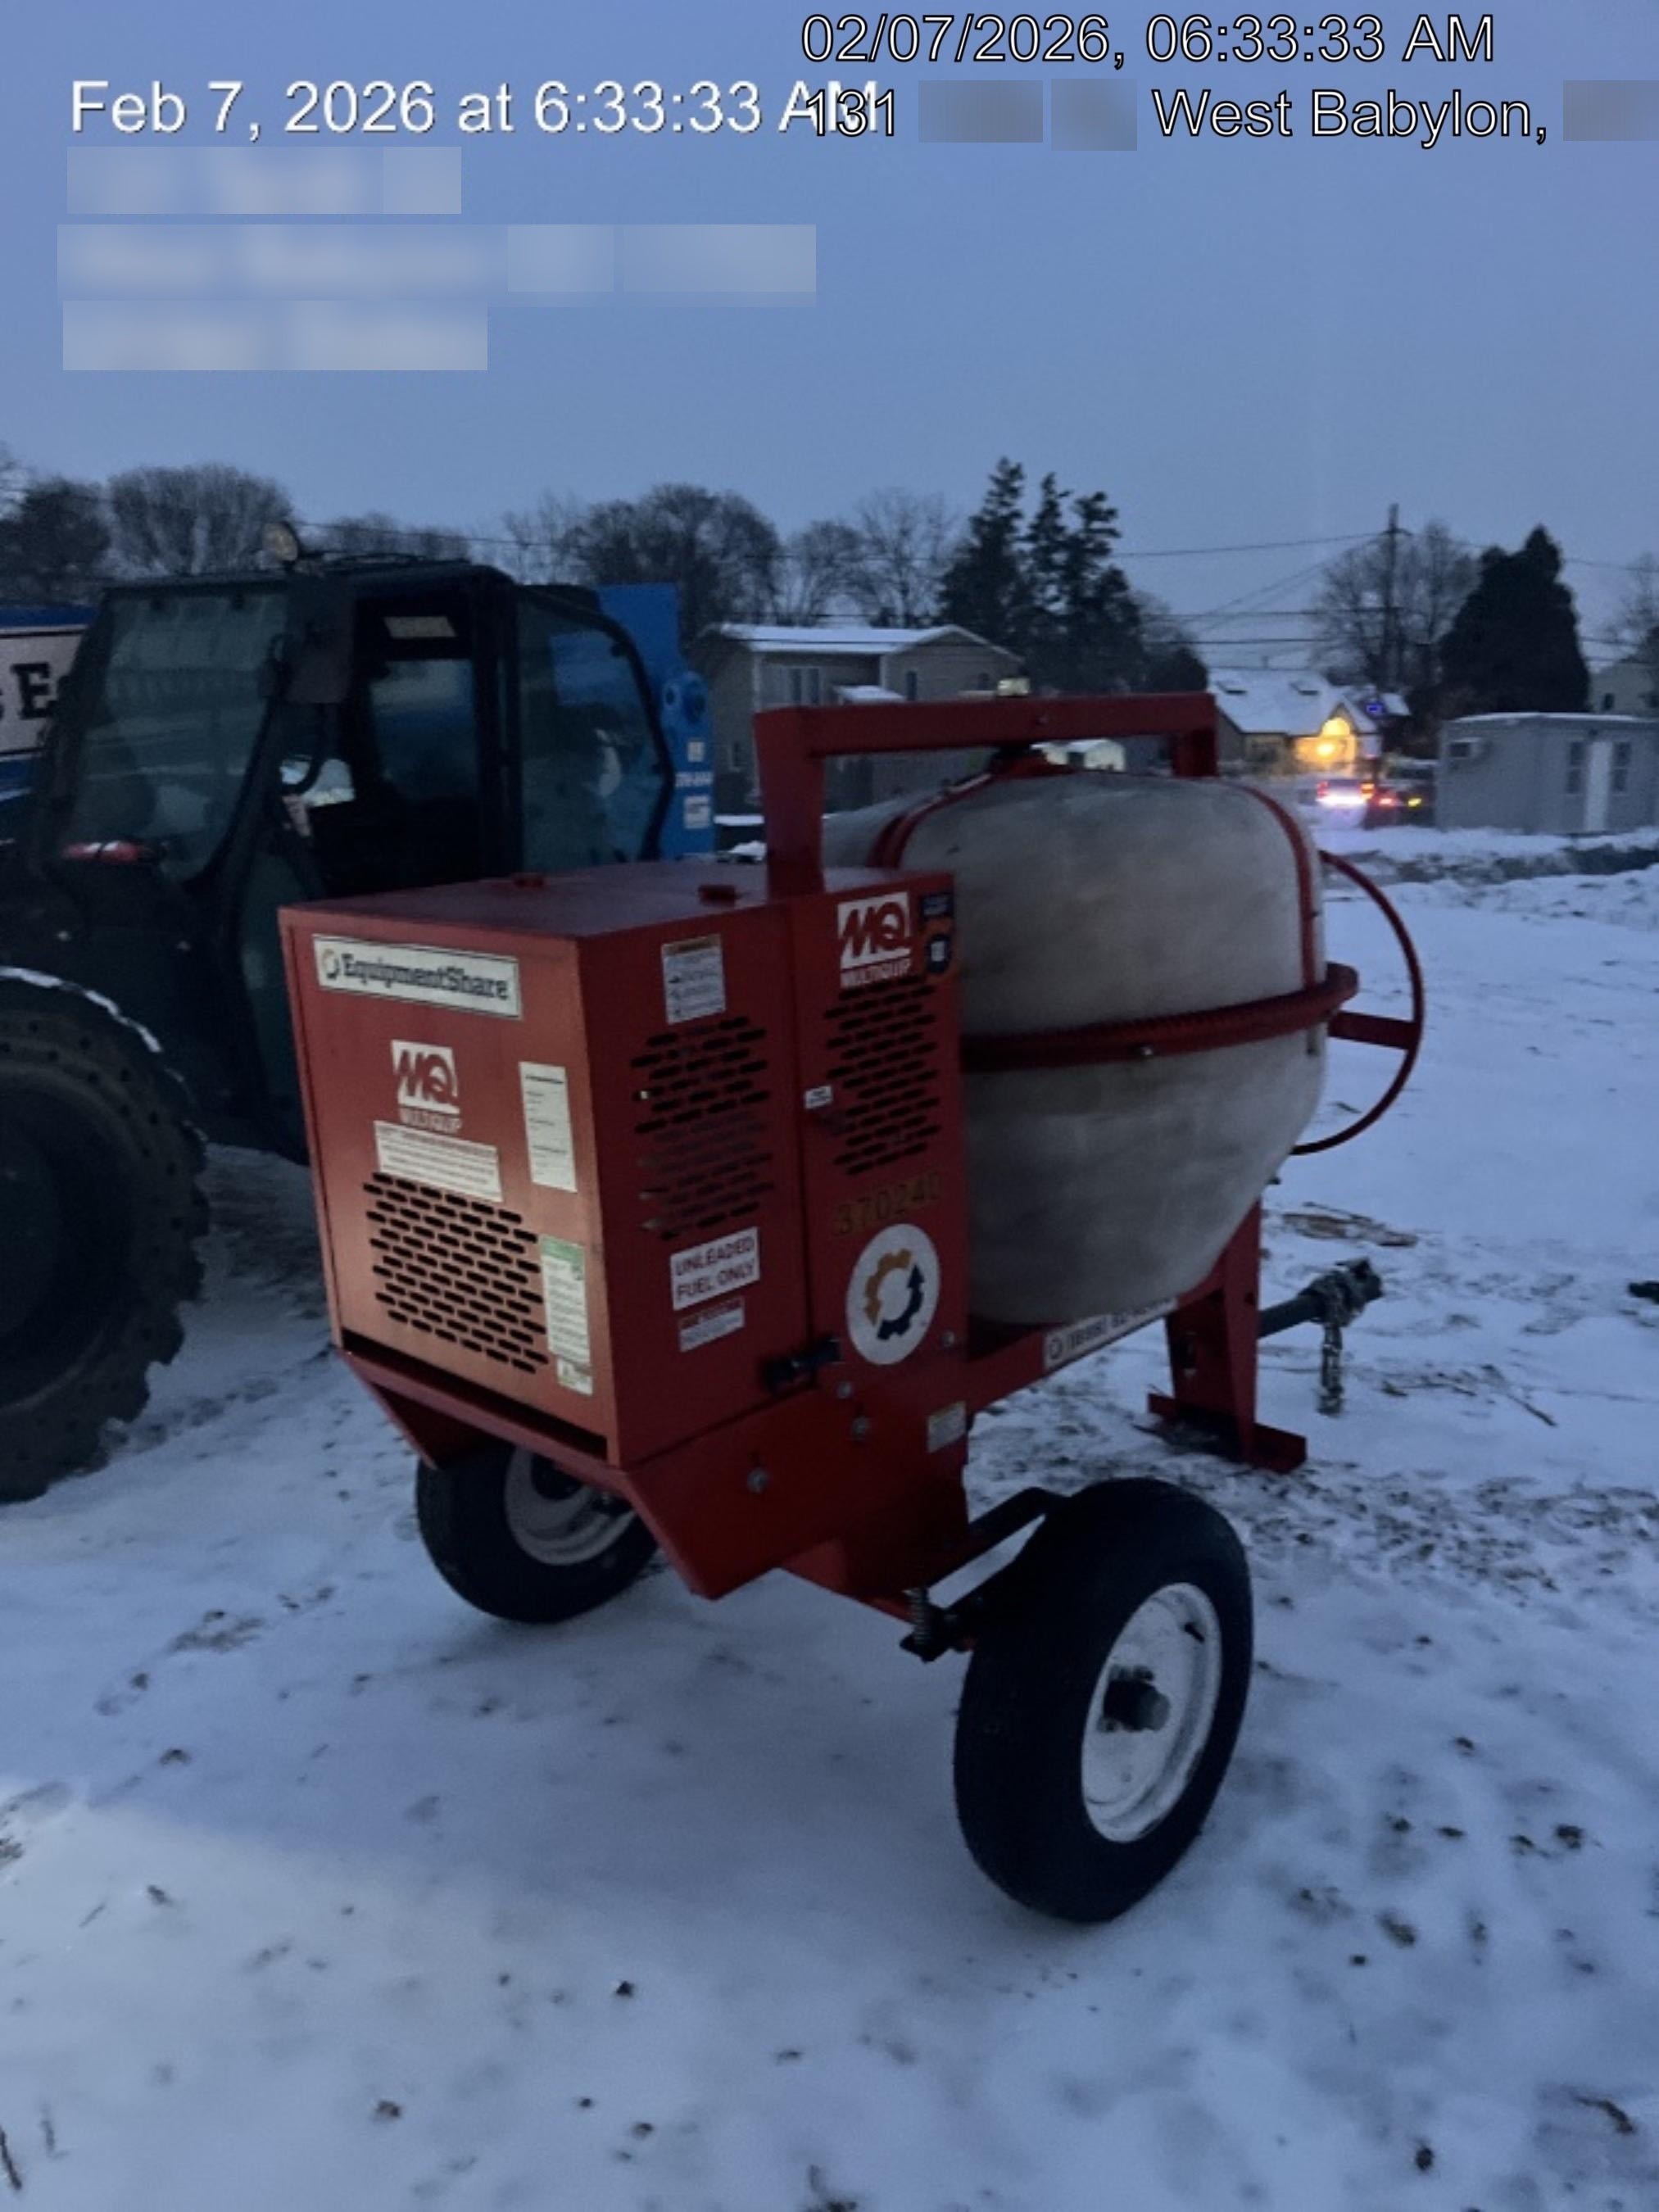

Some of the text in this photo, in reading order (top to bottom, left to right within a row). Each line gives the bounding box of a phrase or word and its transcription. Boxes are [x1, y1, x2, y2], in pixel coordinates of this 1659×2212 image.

[341, 953, 509, 1000] EquipmentShare
[675, 1235, 755, 1276] UNLEADED
[677, 1258, 755, 1301] FUEL ONLY
